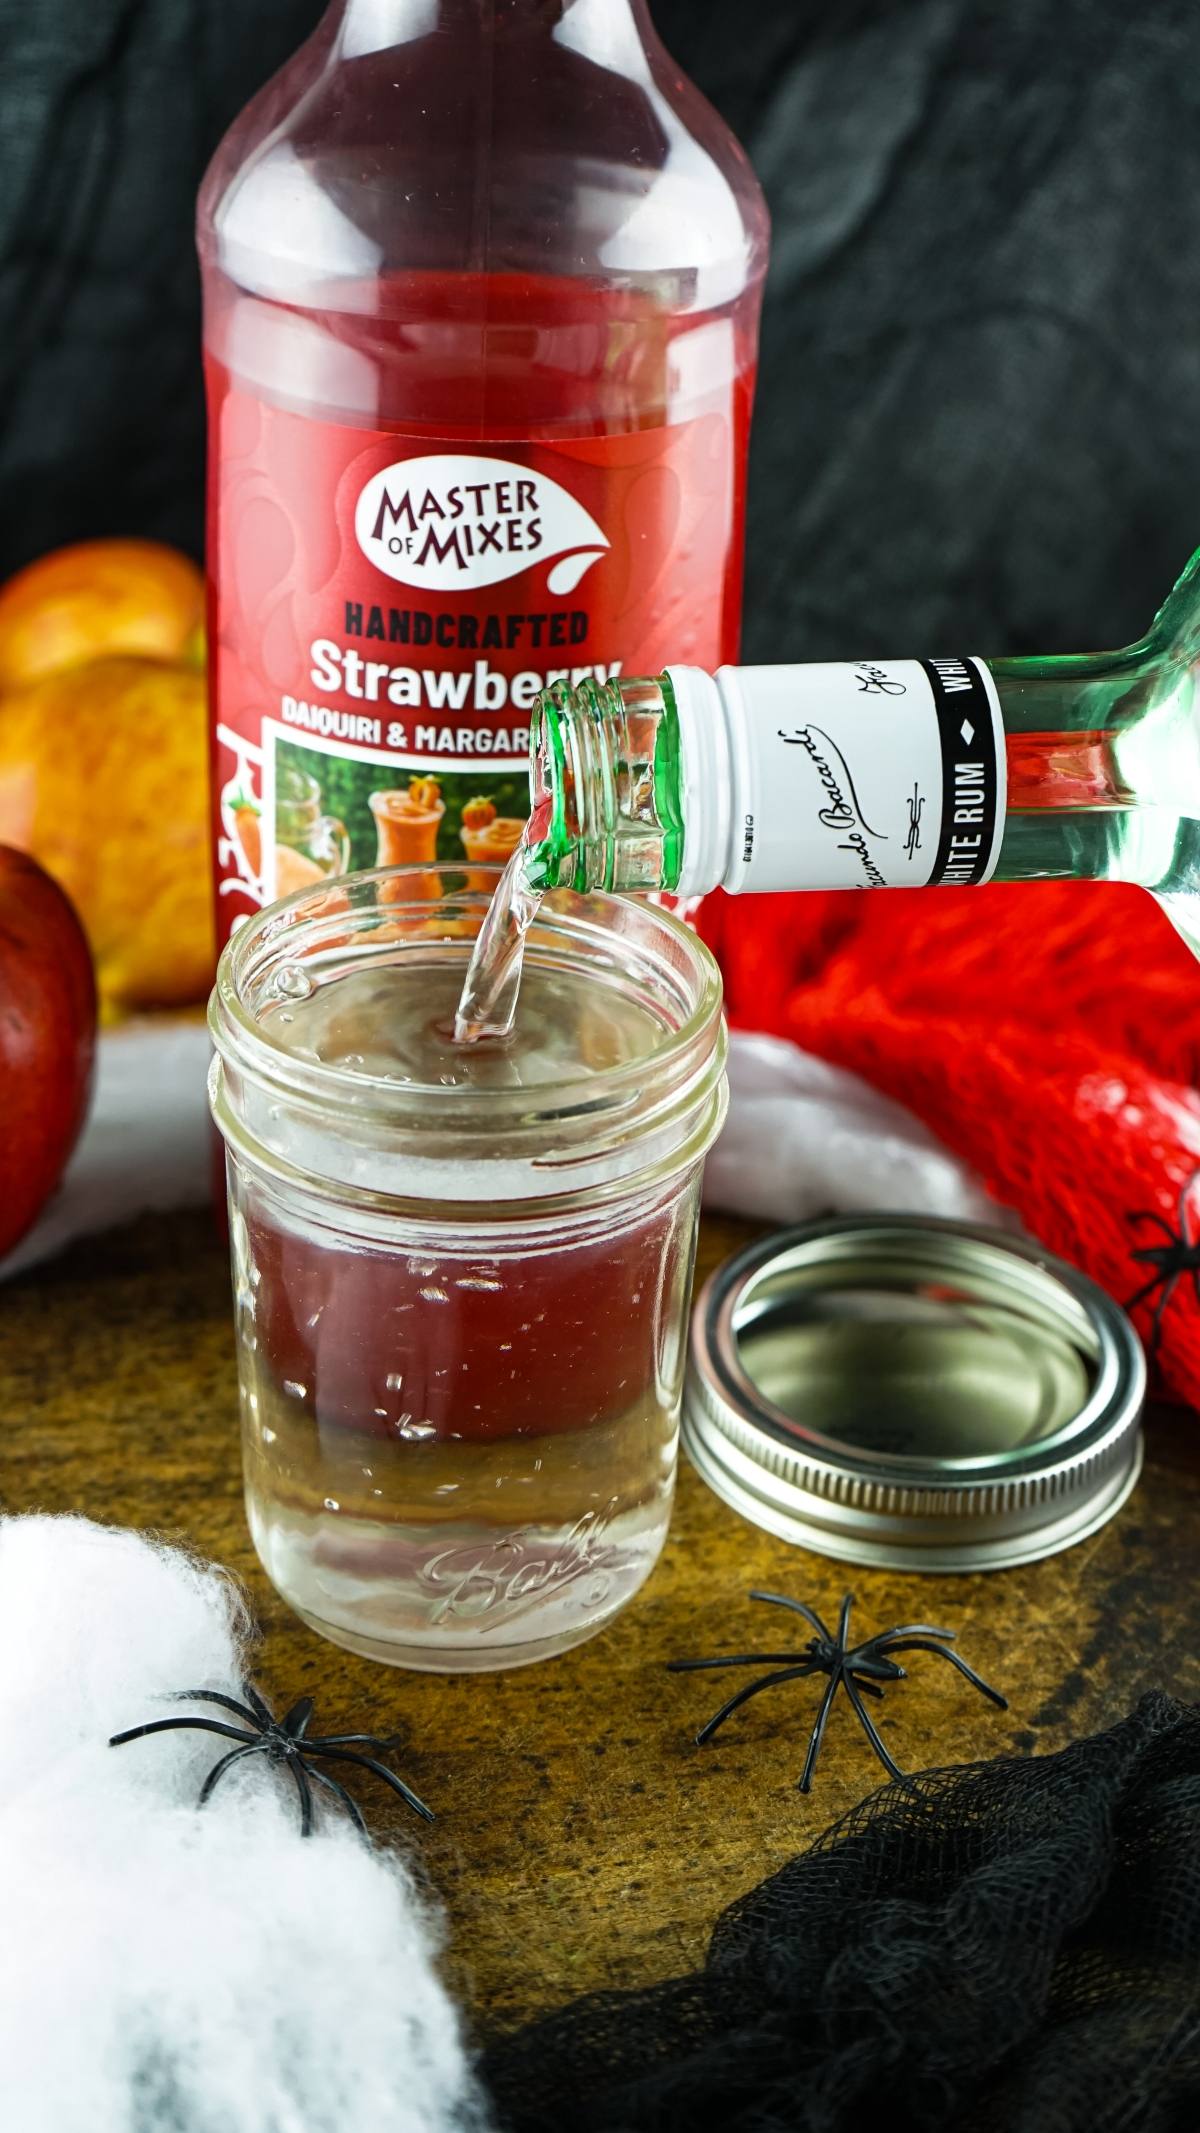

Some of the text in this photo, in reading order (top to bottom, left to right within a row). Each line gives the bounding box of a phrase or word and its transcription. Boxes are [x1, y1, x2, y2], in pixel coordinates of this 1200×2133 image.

[371, 480, 540, 541] MASTER
[387, 517, 543, 570] OF MIXES
[345, 601, 588, 649] HANDCRAFTED
[281, 695, 530, 754] DAIQUIRI & MARGAR
[953, 762, 986, 824] RUM
